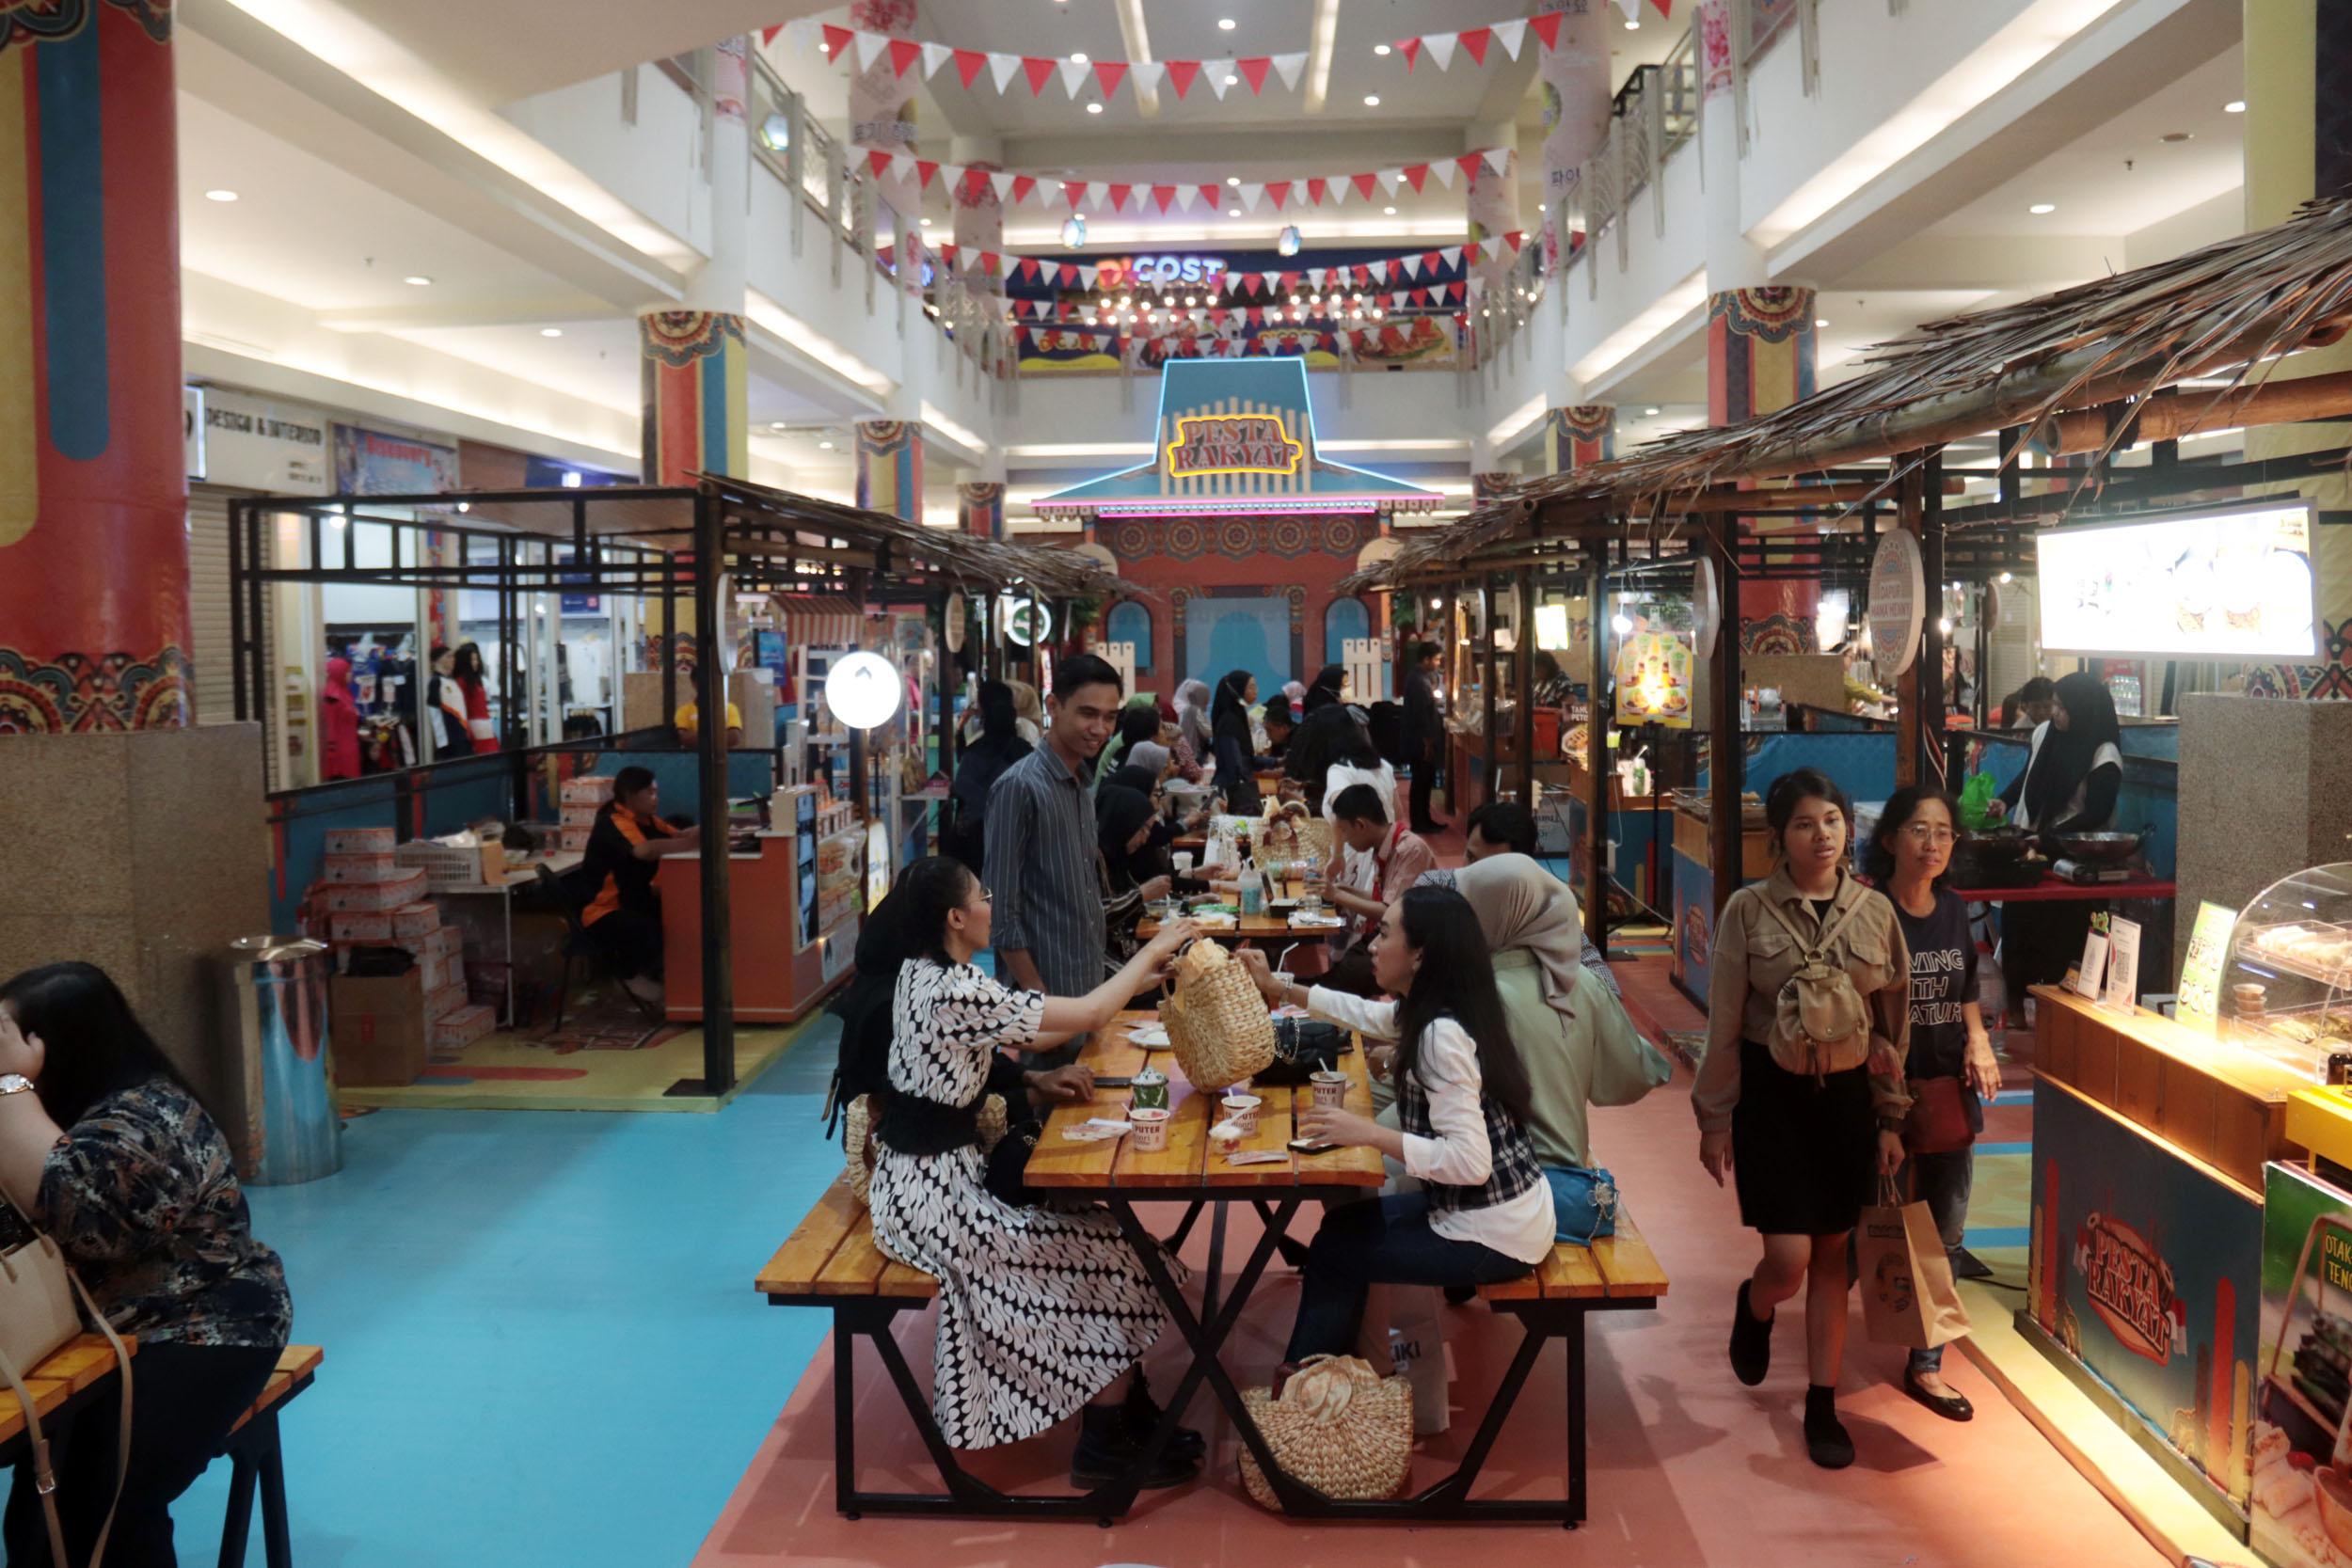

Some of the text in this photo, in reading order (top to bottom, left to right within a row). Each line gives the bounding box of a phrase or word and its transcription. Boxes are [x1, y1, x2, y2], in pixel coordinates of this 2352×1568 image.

[1183, 420, 1282, 446] PESTA
[1175, 443, 1295, 470] RAKYAT
[2326, 1234, 2352, 1265] OTAK
[2096, 1228, 2160, 1313] PESTA
[2088, 1258, 2170, 1353] RAKYAT
[1391, 1339, 1422, 1363] IKI
